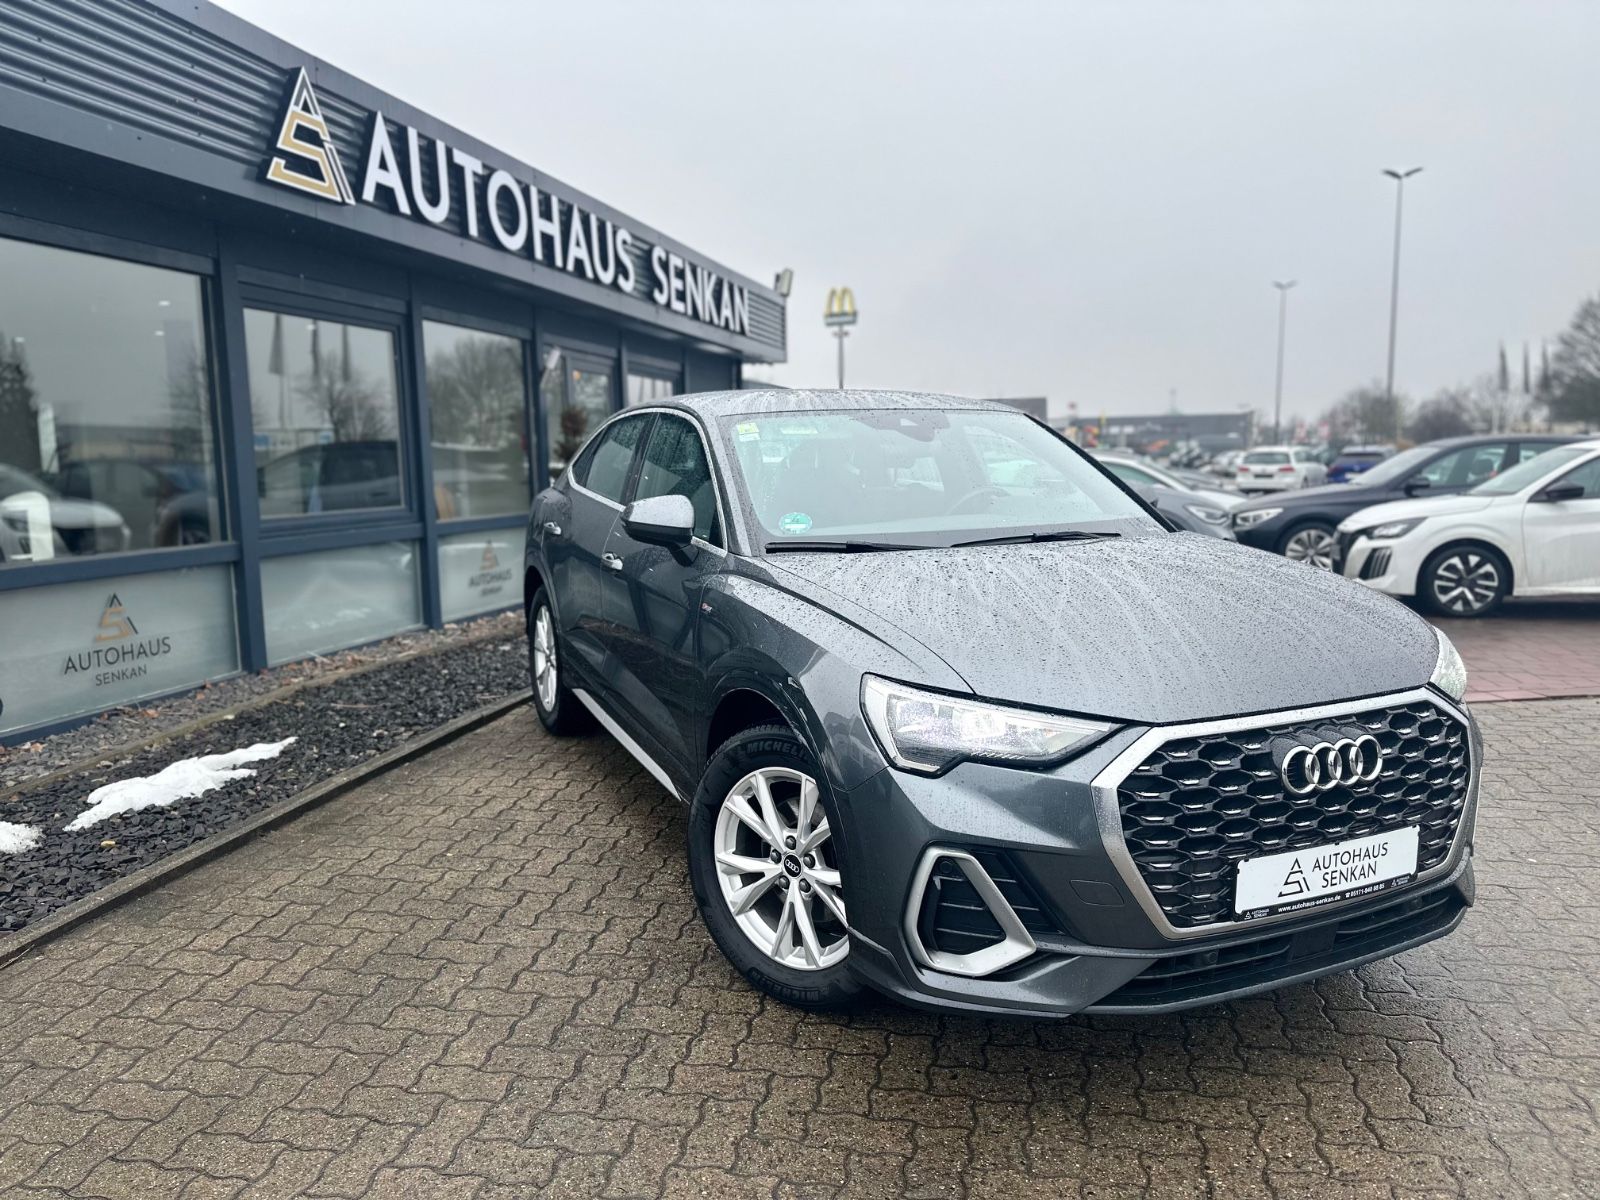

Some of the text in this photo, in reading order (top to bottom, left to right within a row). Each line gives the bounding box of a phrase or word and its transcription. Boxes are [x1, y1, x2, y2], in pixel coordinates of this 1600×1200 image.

[362, 109, 750, 336] AUTOHAUS SENKAN
[64, 636, 171, 675] AUTOHAUS
[95, 664, 147, 687] SENKAN
[1312, 842, 1388, 872] AUTOHAUS
[1322, 861, 1377, 888] SENKAN
[1278, 895, 1341, 912] www.autohaus-senkan.de
